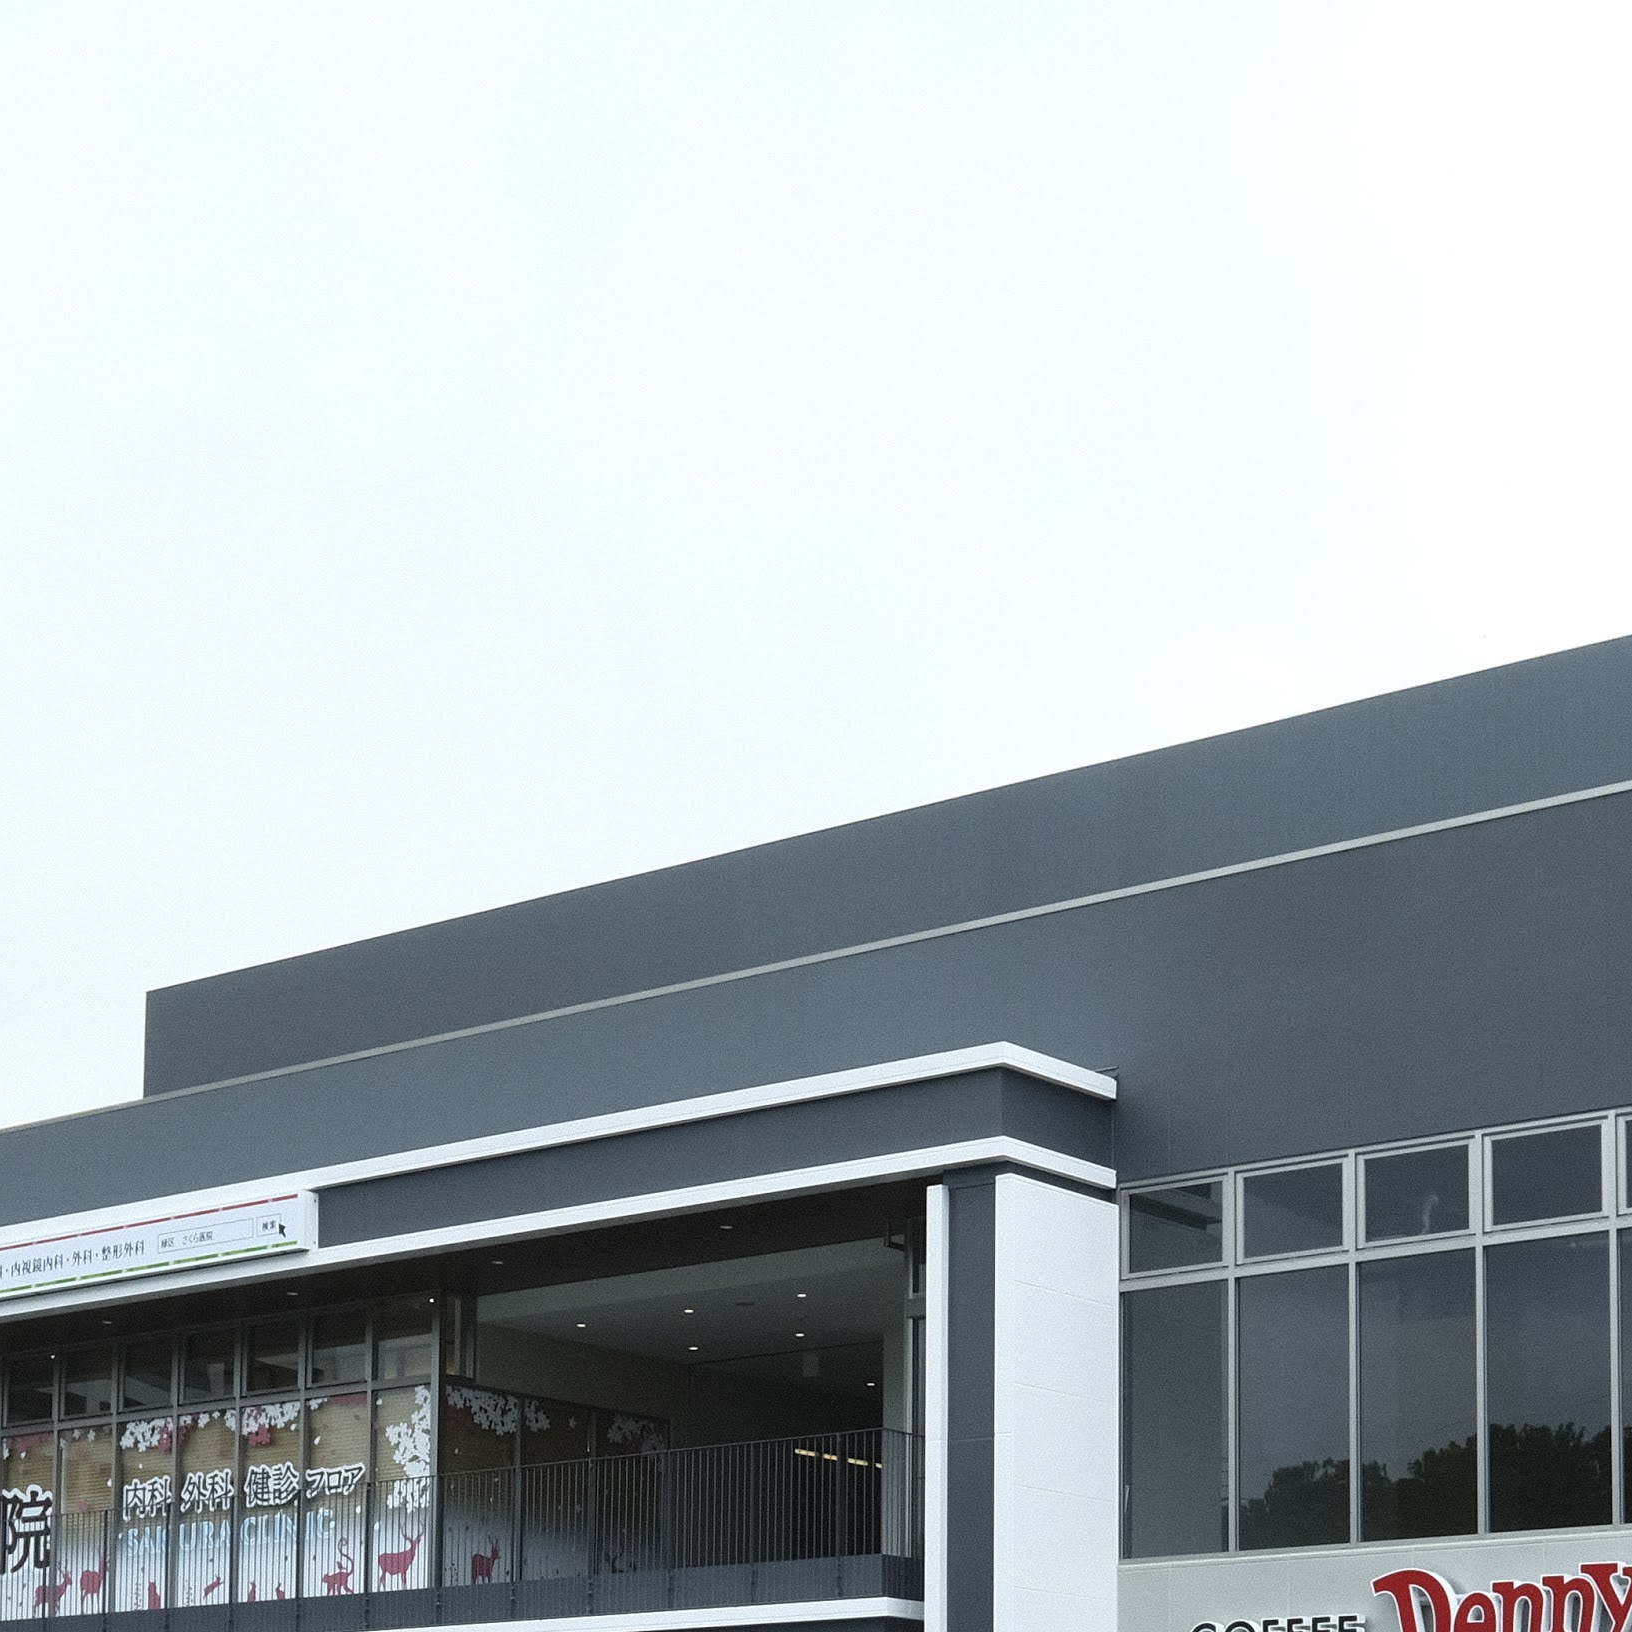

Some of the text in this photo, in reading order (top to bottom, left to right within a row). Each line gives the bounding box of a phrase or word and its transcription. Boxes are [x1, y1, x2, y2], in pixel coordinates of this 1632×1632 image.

[124, 1462, 365, 1521] 内科 外科 健診 フロア
